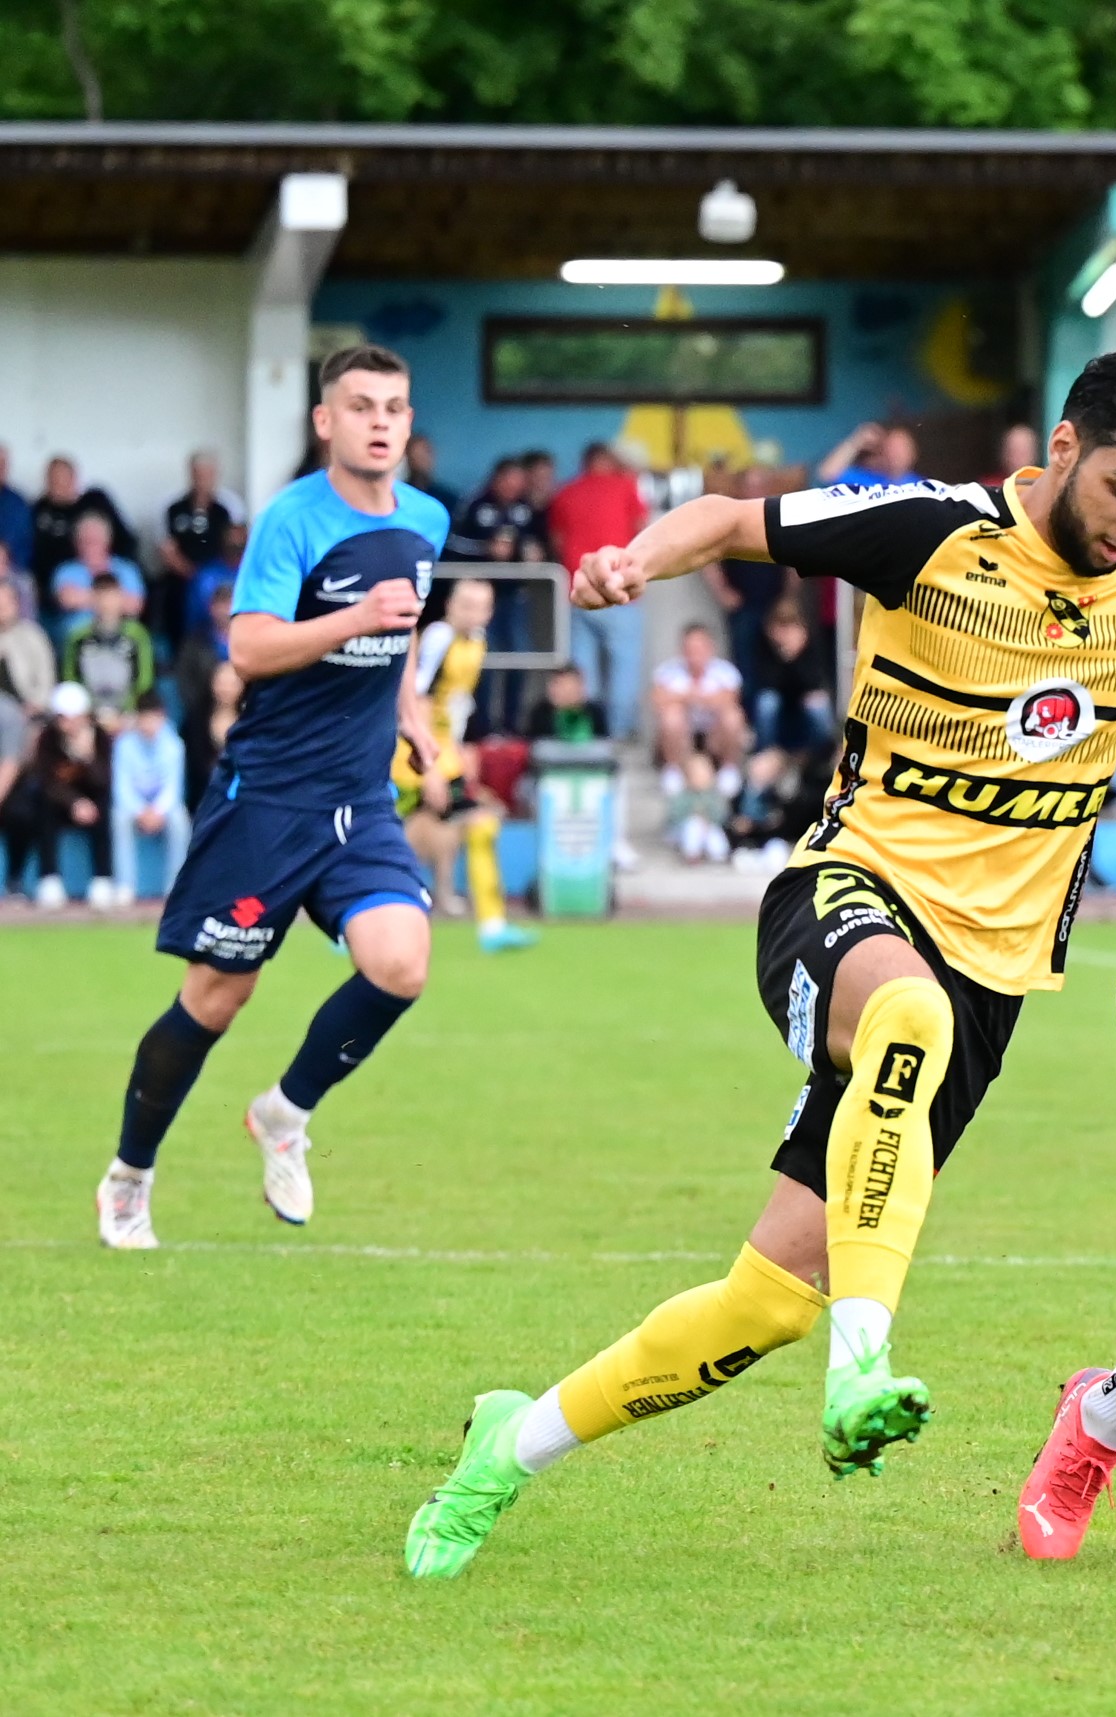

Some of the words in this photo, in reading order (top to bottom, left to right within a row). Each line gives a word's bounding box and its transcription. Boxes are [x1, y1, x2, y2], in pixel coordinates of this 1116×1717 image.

[965, 570, 1007, 588] erima
[882, 1051, 918, 1092] F
[857, 1127, 902, 1230] FICHTNER
